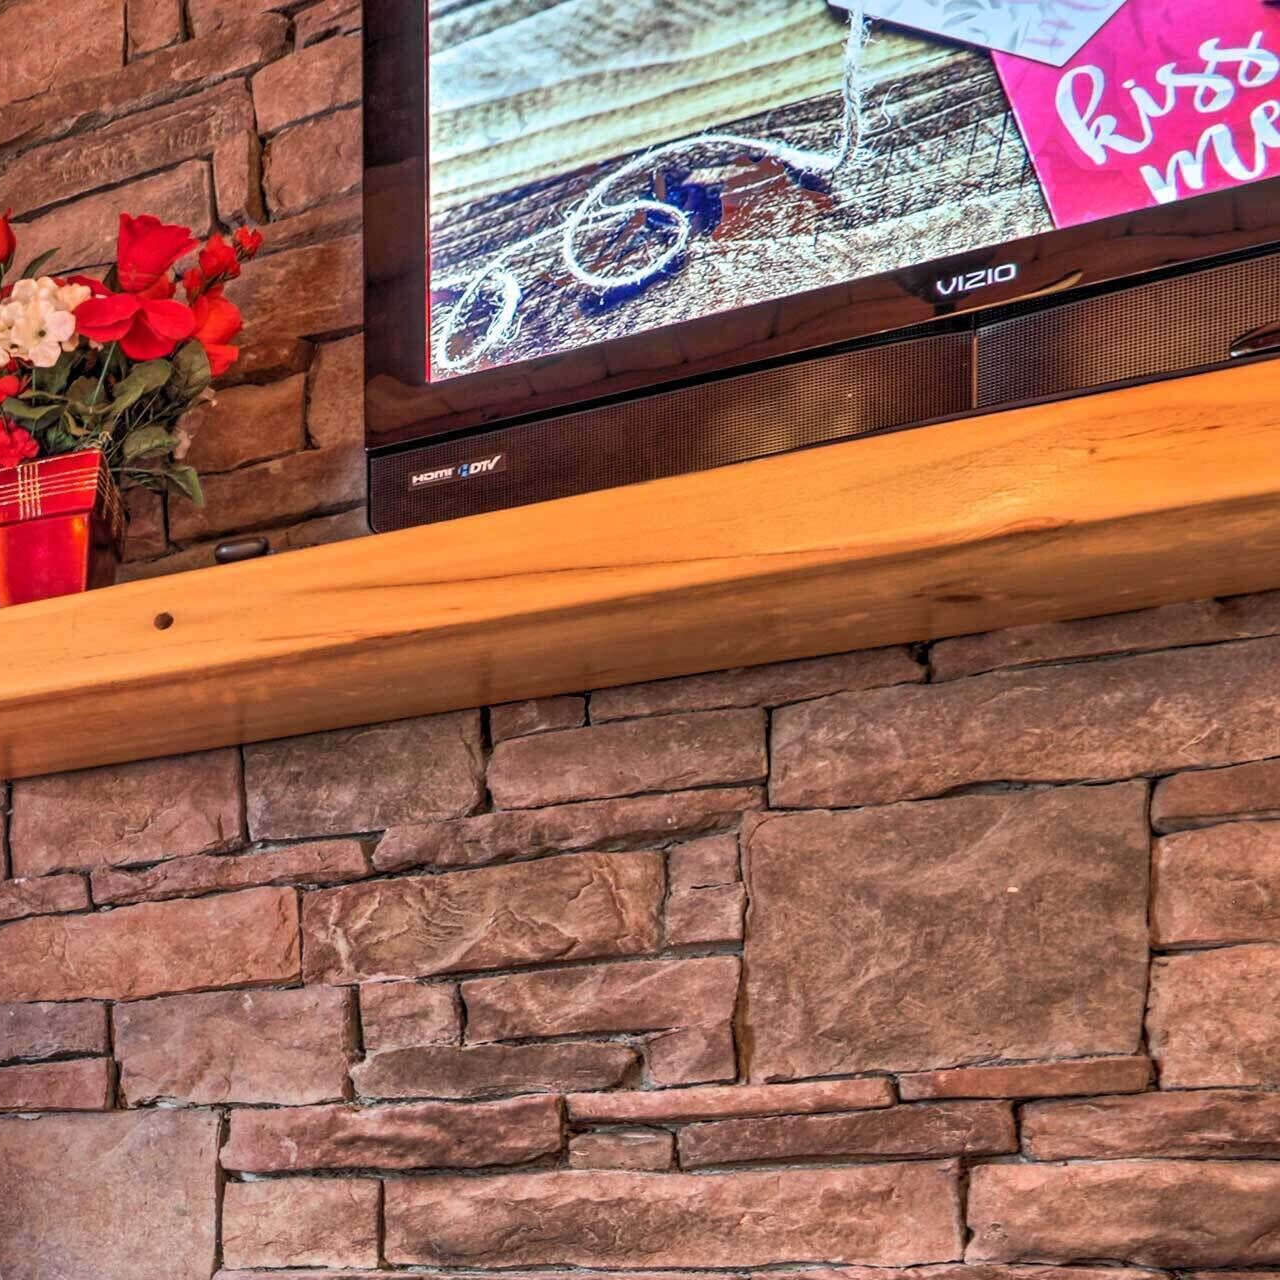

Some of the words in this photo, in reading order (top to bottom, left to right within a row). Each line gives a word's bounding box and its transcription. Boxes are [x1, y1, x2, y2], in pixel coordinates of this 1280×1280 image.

[1055, 31, 1279, 165] kiss
[936, 263, 1017, 295] VIZIO
[412, 467, 454, 486] HDMI
[458, 455, 502, 477] HDTV
